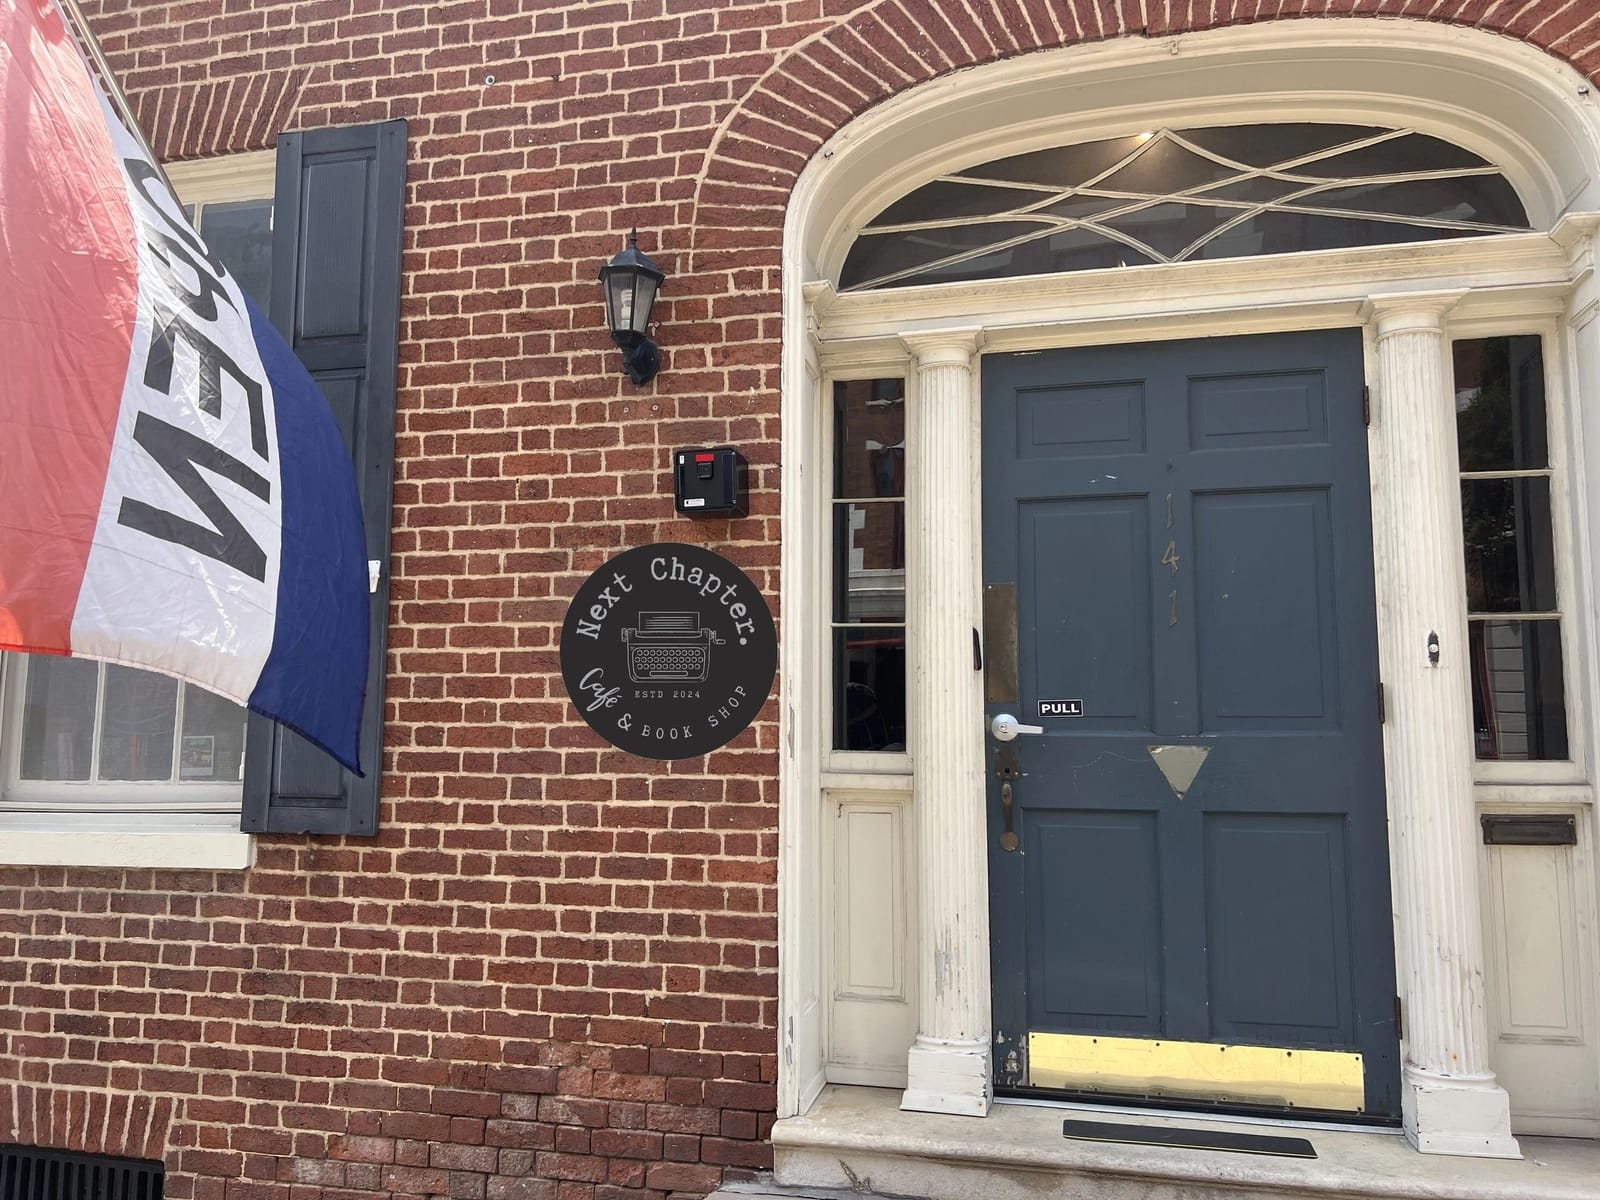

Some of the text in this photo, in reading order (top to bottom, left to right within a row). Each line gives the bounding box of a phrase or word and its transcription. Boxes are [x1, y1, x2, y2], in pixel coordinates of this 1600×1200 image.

[1159, 493, 1181, 627] 141
[576, 557, 755, 646] Next Chapter.
[579, 667, 747, 740] Café & BOOK SHOP
[635, 690, 701, 699] ESTD 2024
[1041, 703, 1080, 714] PULL
